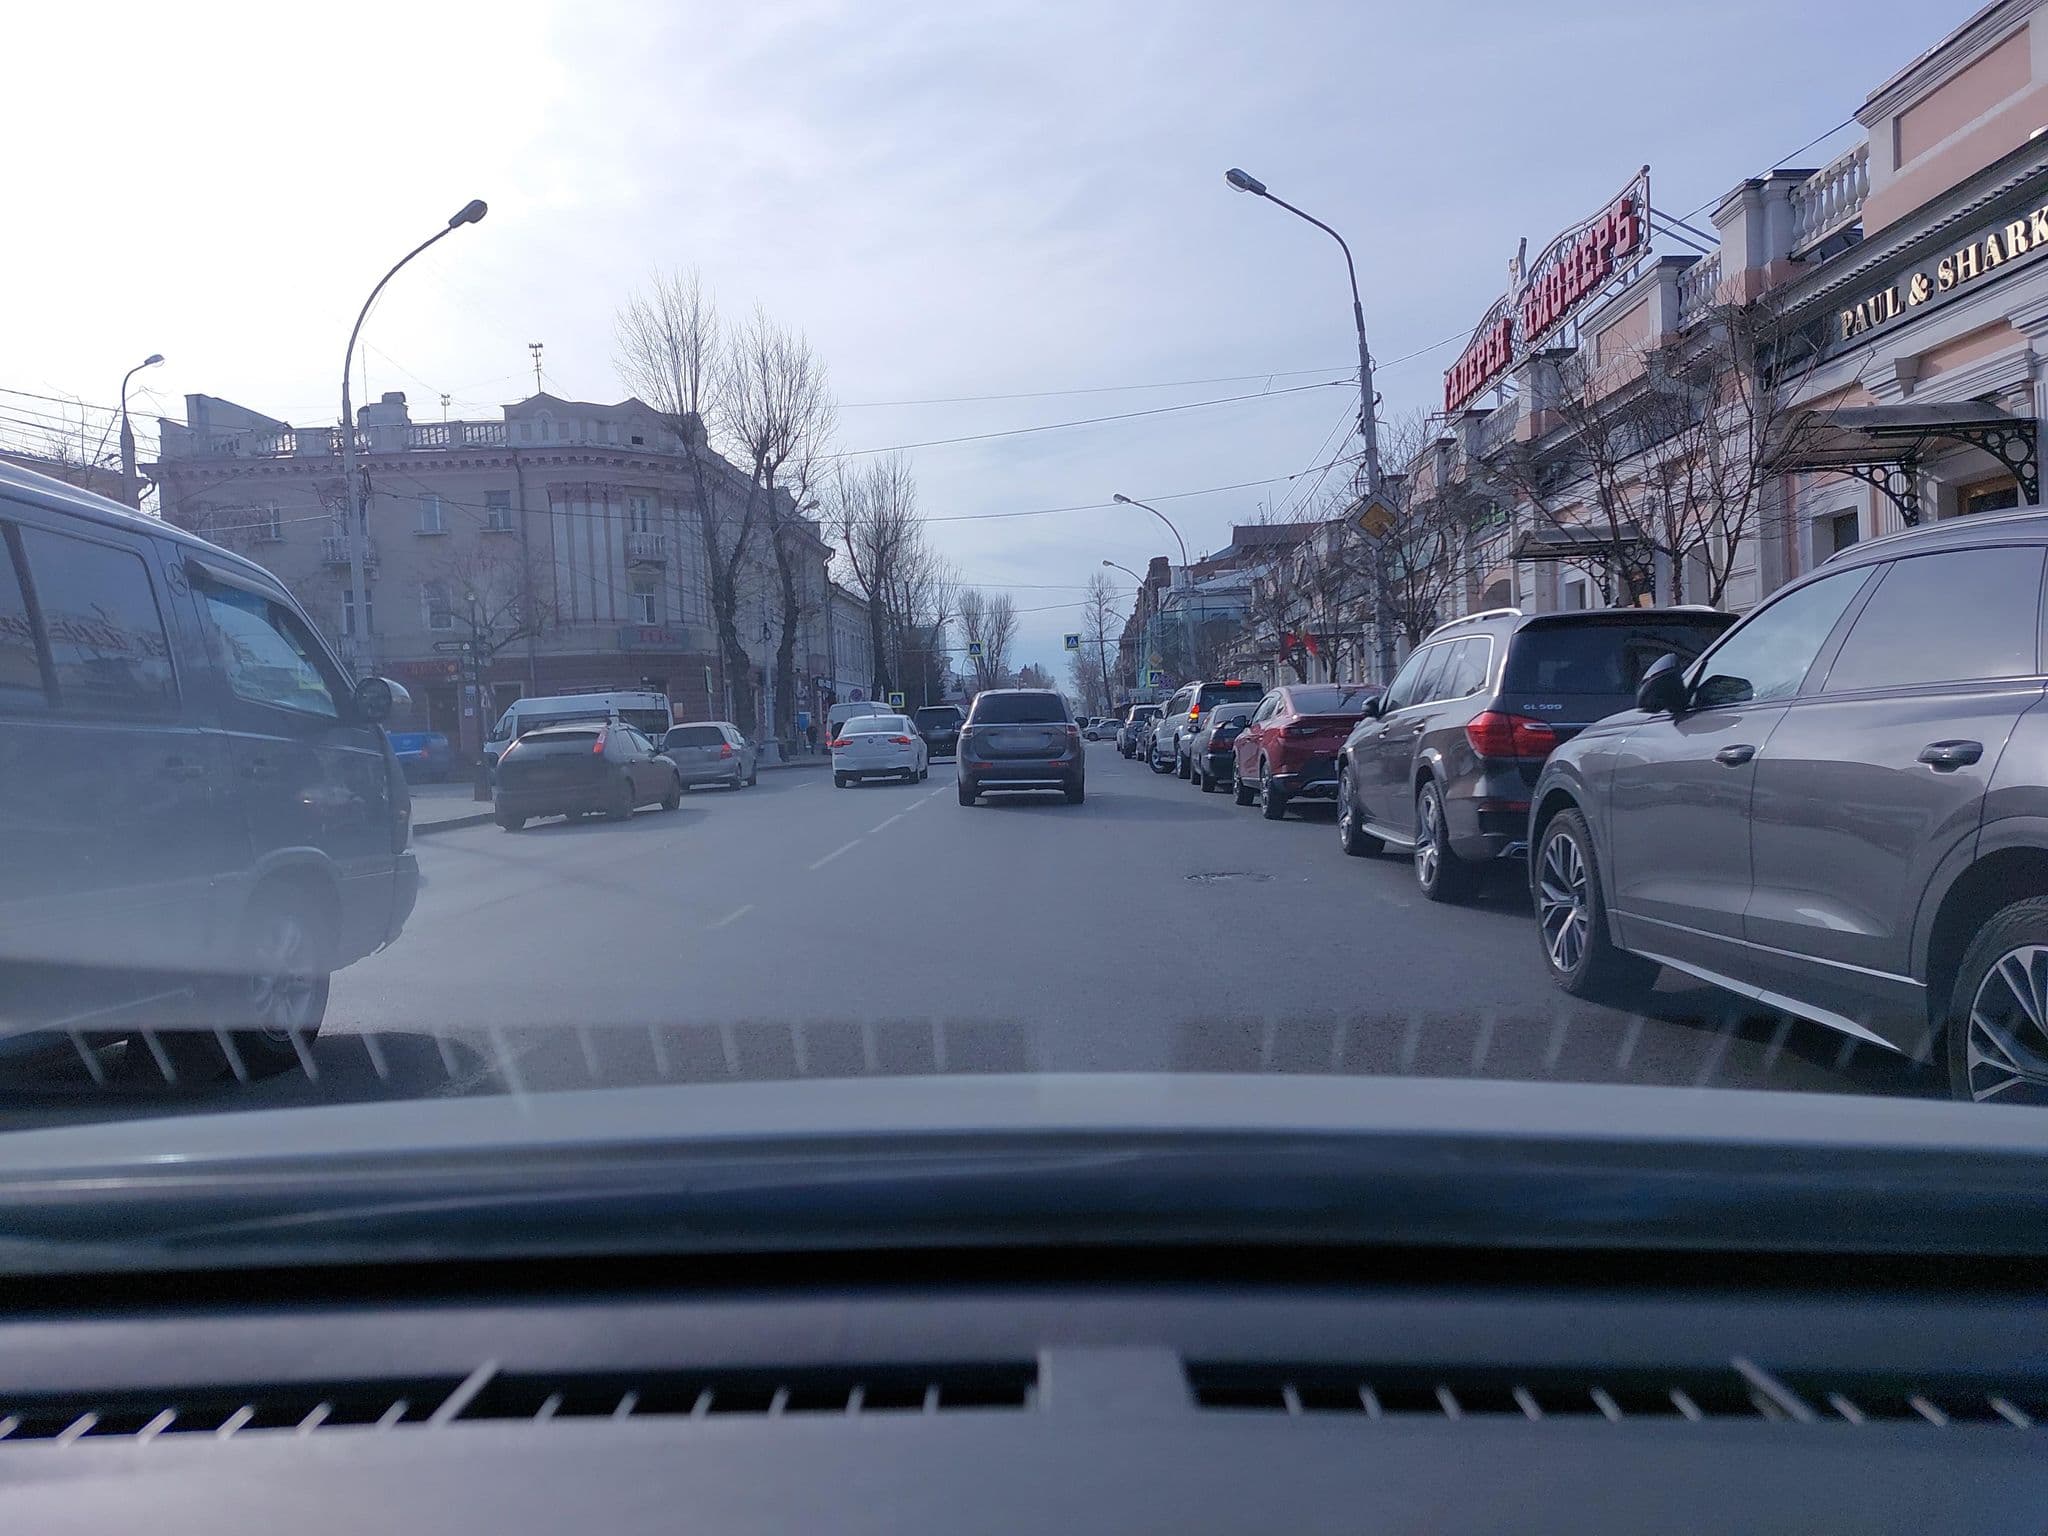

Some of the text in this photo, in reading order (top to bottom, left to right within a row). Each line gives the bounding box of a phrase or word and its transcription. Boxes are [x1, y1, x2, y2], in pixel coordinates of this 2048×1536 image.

[1444, 198, 1639, 412] ГАЛЕРЕЯ ПИОНЕРЪ
[1841, 204, 2048, 341] PAUL & SHARK
